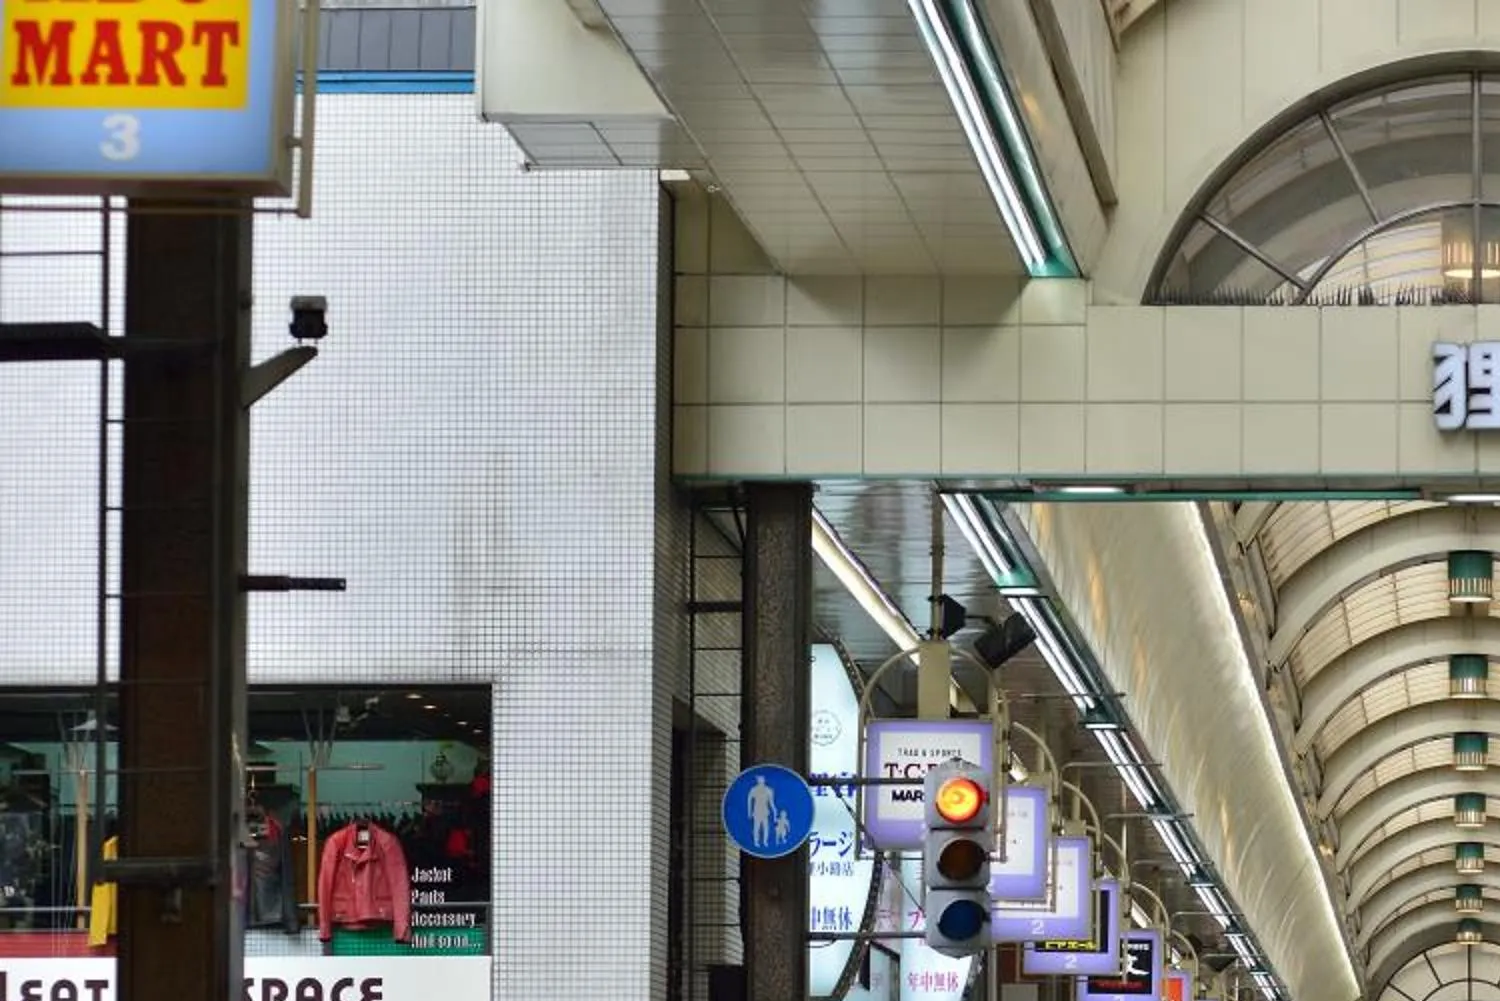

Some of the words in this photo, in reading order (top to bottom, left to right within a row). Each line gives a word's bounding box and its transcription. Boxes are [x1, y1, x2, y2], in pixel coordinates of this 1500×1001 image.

[11, 20, 241, 87] MART
[100, 114, 140, 160] 3
[892, 789, 926, 802] MAR
[1030, 919, 1045, 935] 2
